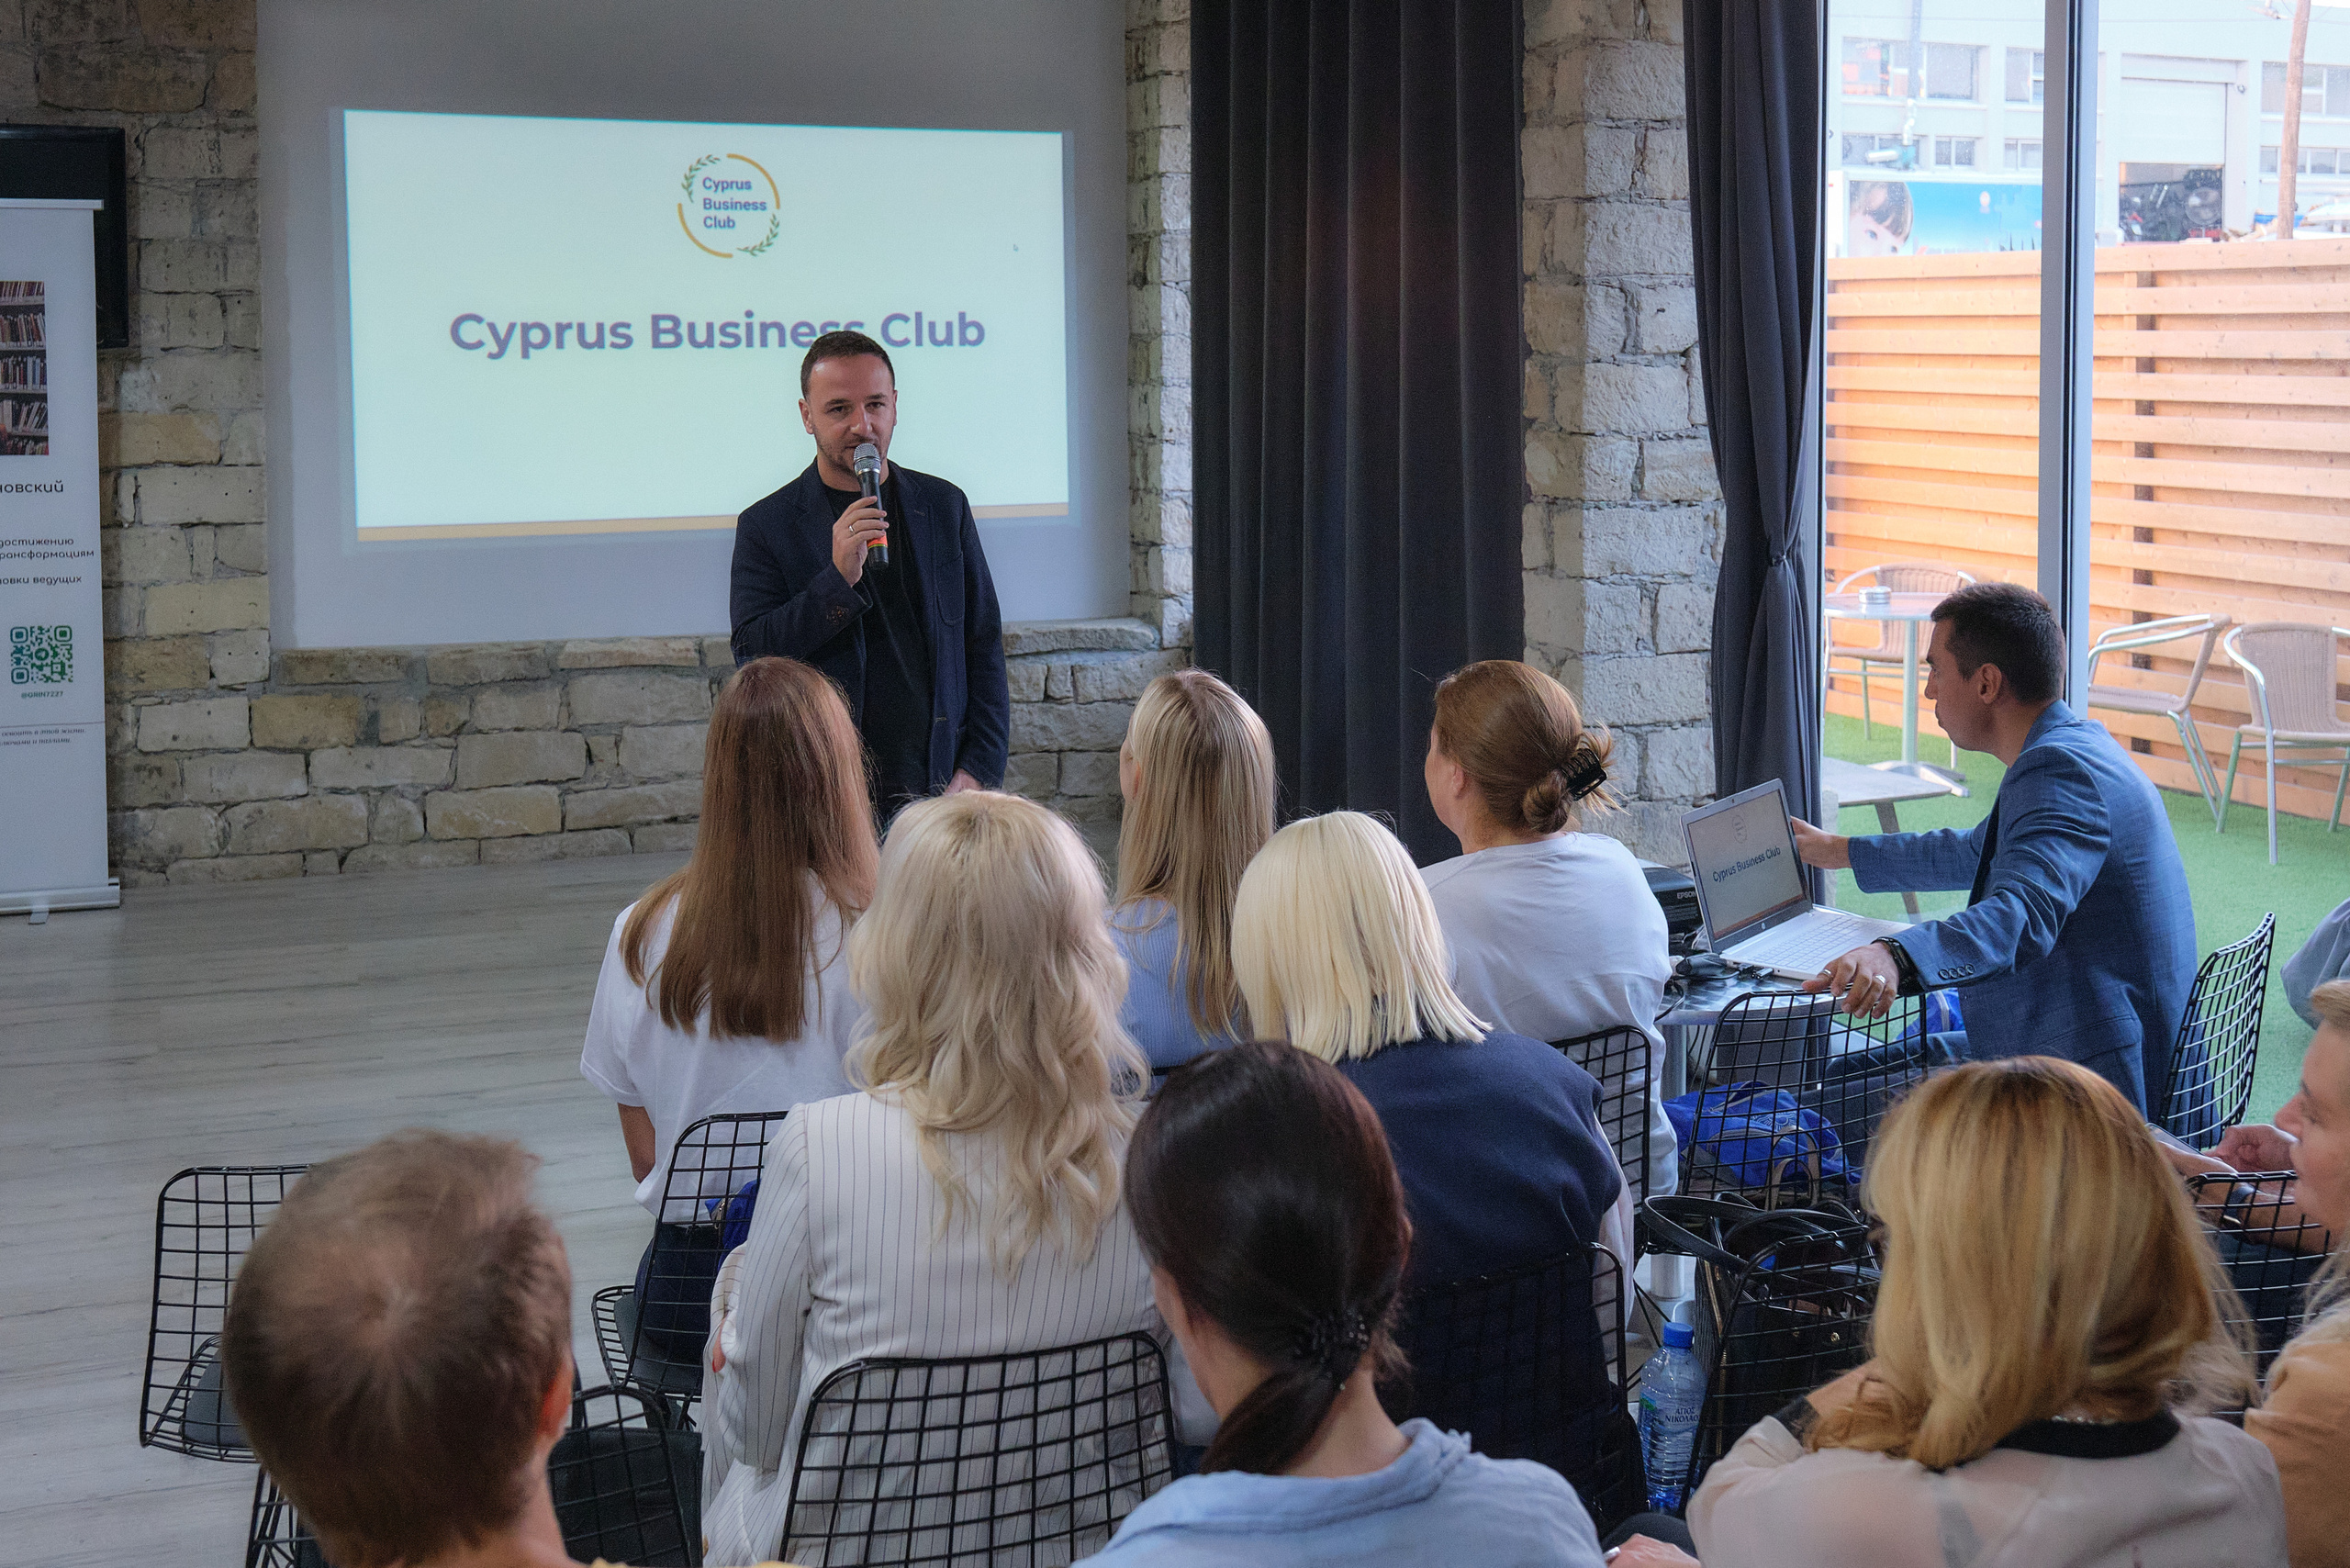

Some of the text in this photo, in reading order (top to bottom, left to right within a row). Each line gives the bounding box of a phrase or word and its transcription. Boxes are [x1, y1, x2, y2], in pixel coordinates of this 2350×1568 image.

[702, 176, 753, 193] Cyprus
[703, 197, 767, 211] Business
[703, 216, 736, 229] Club
[450, 312, 634, 360] Cyprus
[880, 311, 986, 347] Club
[0, 479, 64, 494] овский
[0, 577, 29, 585] овки
[1712, 846, 1781, 883] Cyprus Business Club
[1664, 1415, 1699, 1423] ΝΙΚΟΛΑΟ
